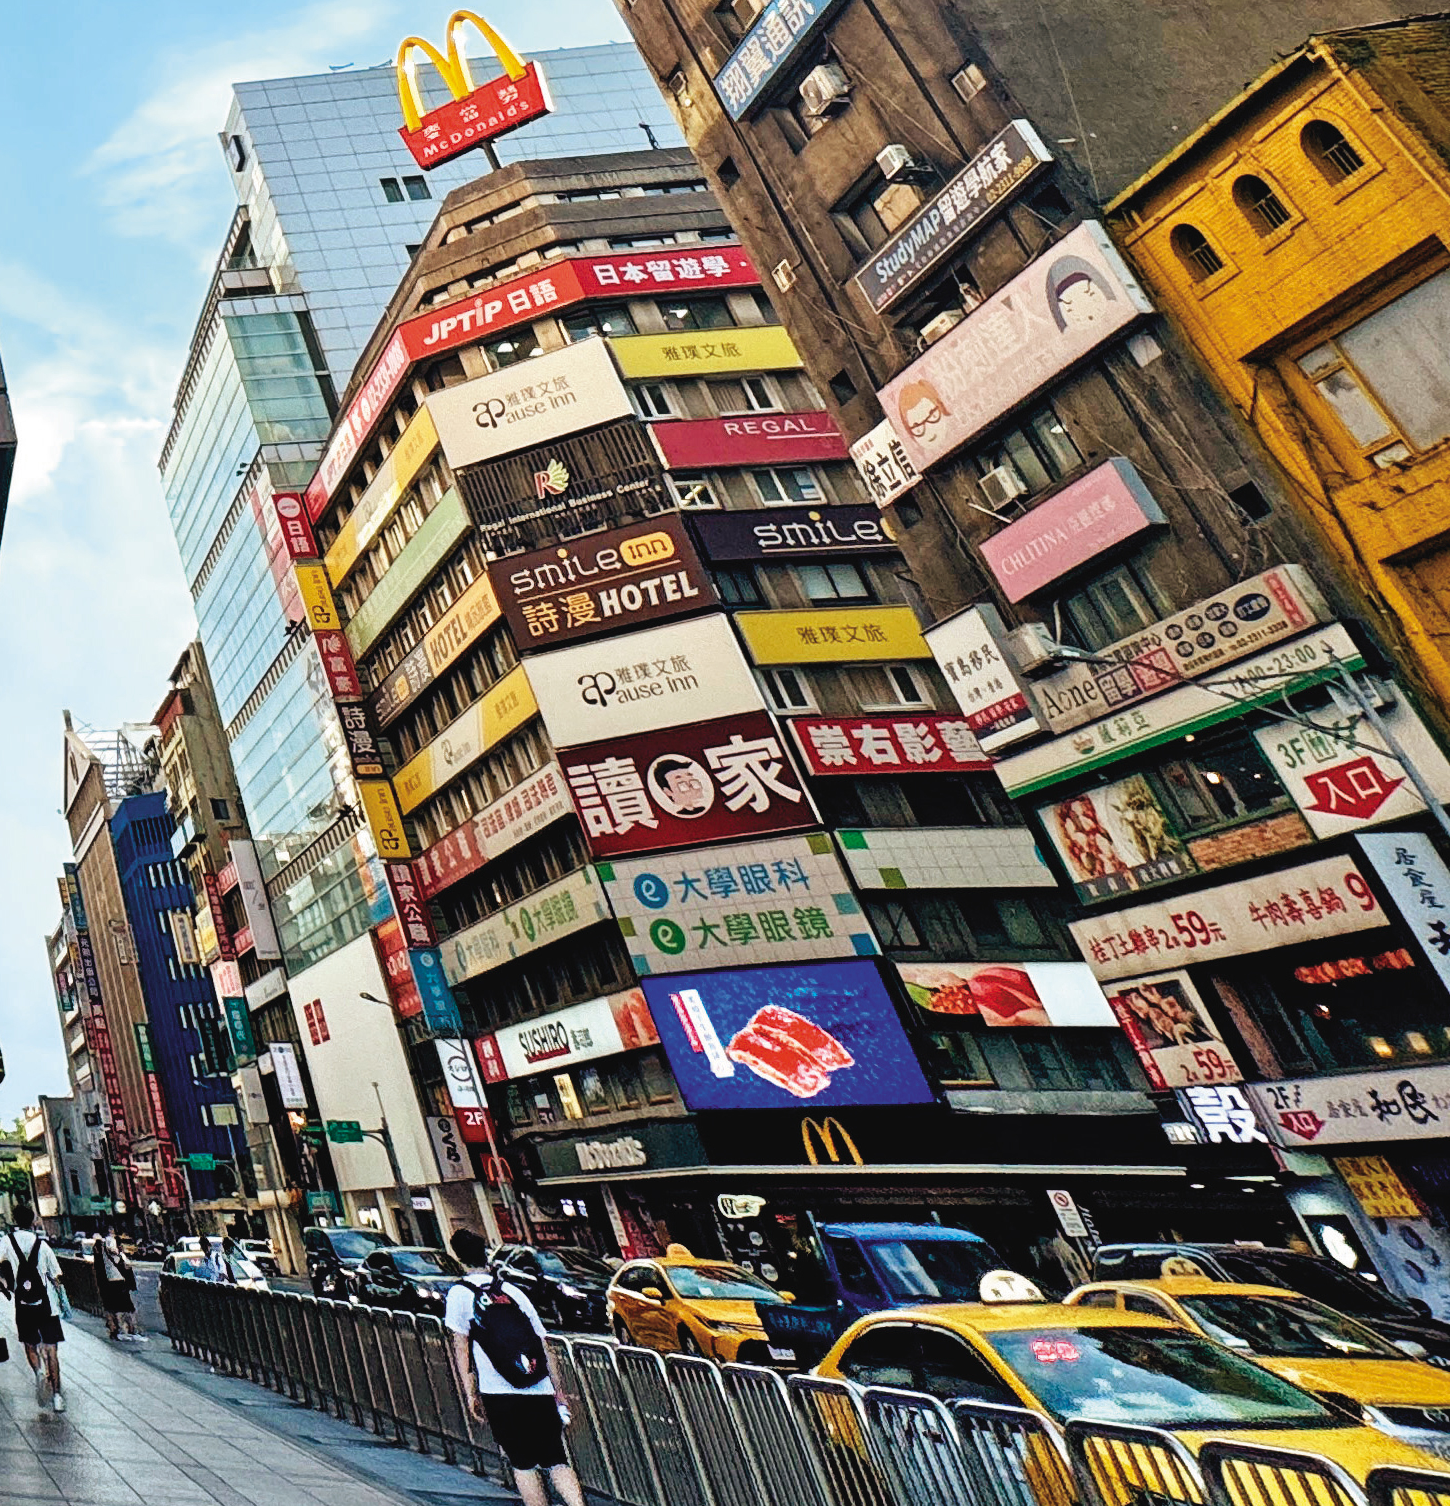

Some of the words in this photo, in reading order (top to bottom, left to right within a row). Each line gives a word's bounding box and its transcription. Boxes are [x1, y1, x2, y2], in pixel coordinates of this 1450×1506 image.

[423, 100, 529, 158] McDonald's
[511, 277, 559, 315] 日語
[595, 251, 730, 286] 日本留遊學
[725, 418, 816, 436] REGAL
[1001, 523, 1068, 578] CHLITINA
[521, 590, 601, 637] 詩漫
[599, 569, 699, 618] HOTEL
[808, 720, 989, 766] 崇右影藝
[1277, 737, 1306, 769] 3F
[1317, 765, 1383, 810] 入口
[673, 856, 810, 903] 大學眼科
[691, 906, 835, 949] 大學眼鏡
[516, 1021, 571, 1061] SUSHIRO
